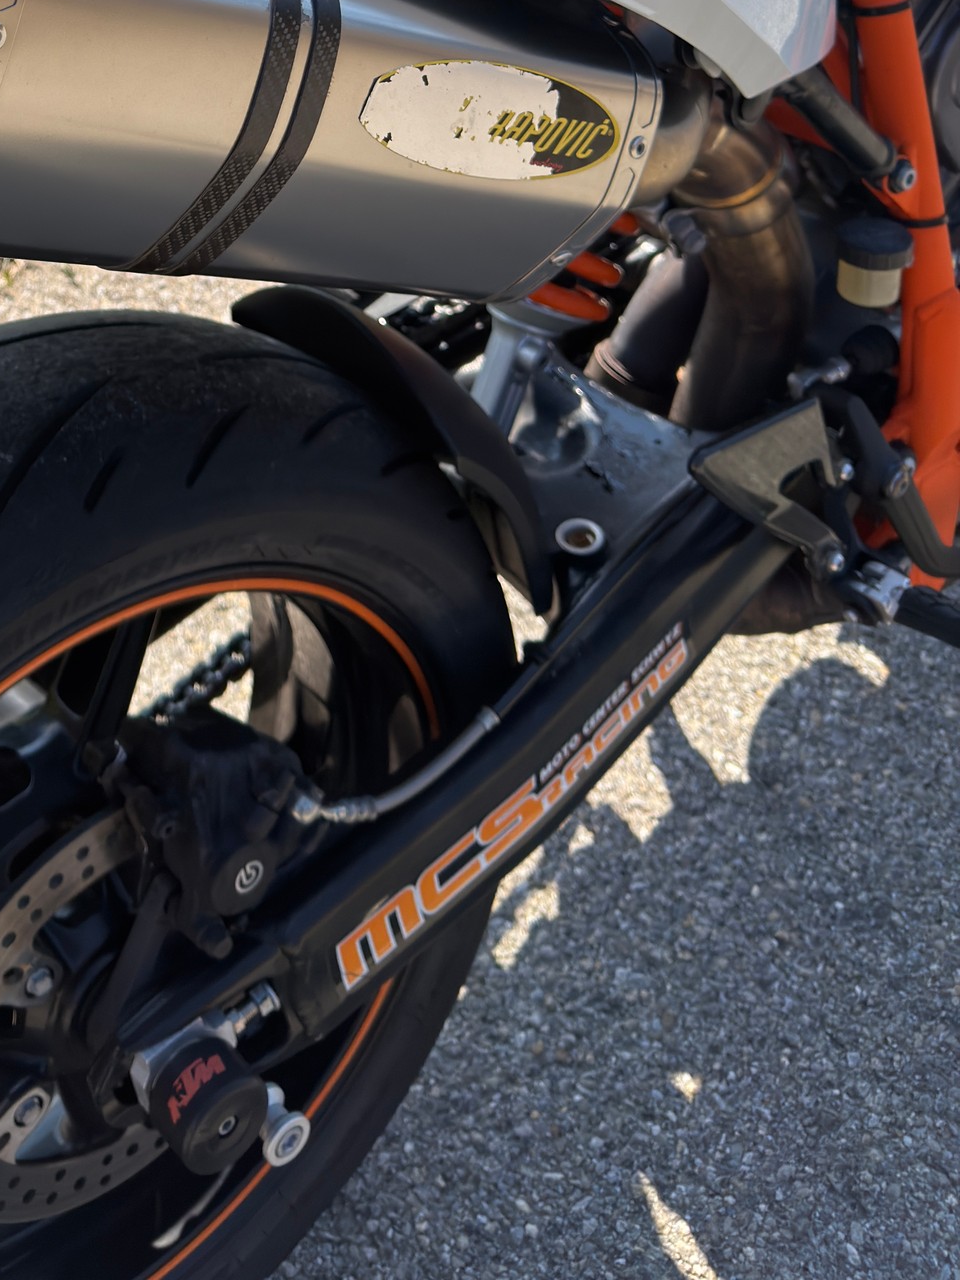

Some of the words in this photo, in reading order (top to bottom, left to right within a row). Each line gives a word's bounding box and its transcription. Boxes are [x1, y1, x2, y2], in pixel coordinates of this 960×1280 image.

[540, 732, 583, 784] MOTO
[582, 679, 632, 736] CENTER
[167, 1054, 226, 1124] KTM
